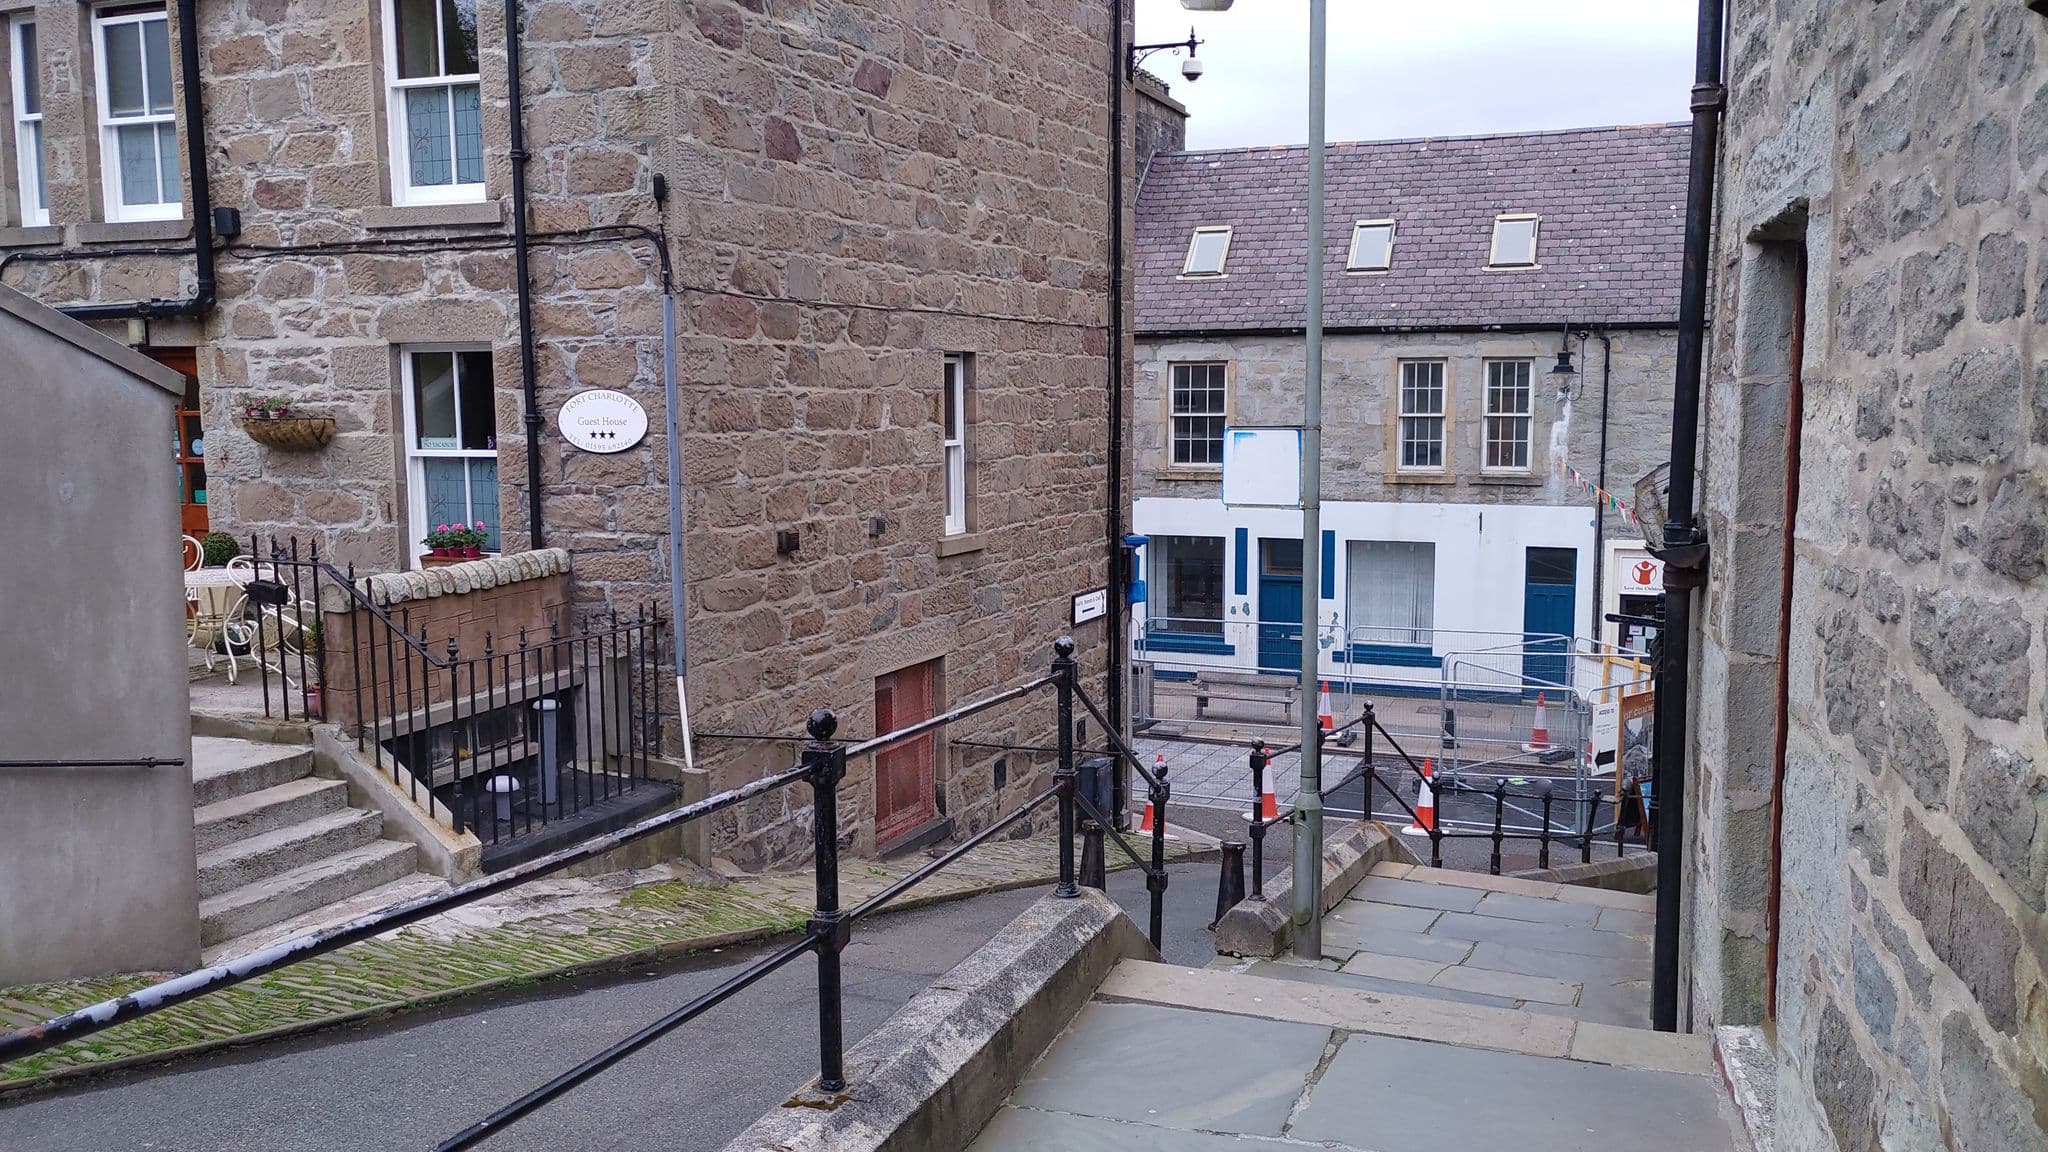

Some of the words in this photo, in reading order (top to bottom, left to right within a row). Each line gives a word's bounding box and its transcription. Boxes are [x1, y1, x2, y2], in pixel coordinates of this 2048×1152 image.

[565, 394, 586, 413] FORT
[588, 392, 639, 414] CHARLOTTE
[577, 416, 600, 426] Guest
[602, 416, 628, 426] House
